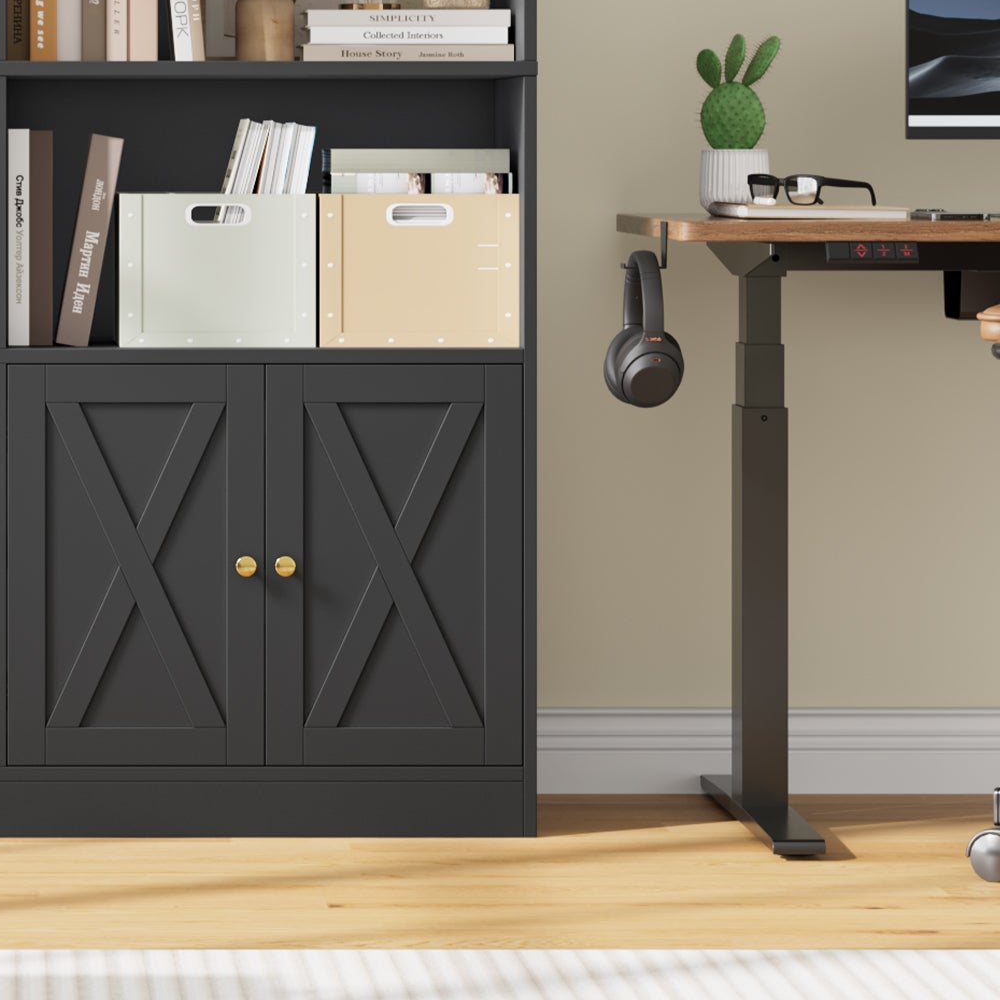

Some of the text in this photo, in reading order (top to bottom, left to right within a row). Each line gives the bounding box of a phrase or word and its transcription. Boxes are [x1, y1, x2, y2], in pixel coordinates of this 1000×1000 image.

[37, 10, 45, 26] we
[369, 14, 435, 22] SIMPLICITY
[37, 29, 45, 50] see
[362, 29, 444, 40] Collected Interiors
[341, 49, 373, 58] House
[375, 49, 403, 60] Story
[90, 178, 105, 211] ЛОНДОН
[15, 174, 25, 304] Стив Джобс Уолтер Айзексон
[72, 230, 101, 314] Мартин Иден
